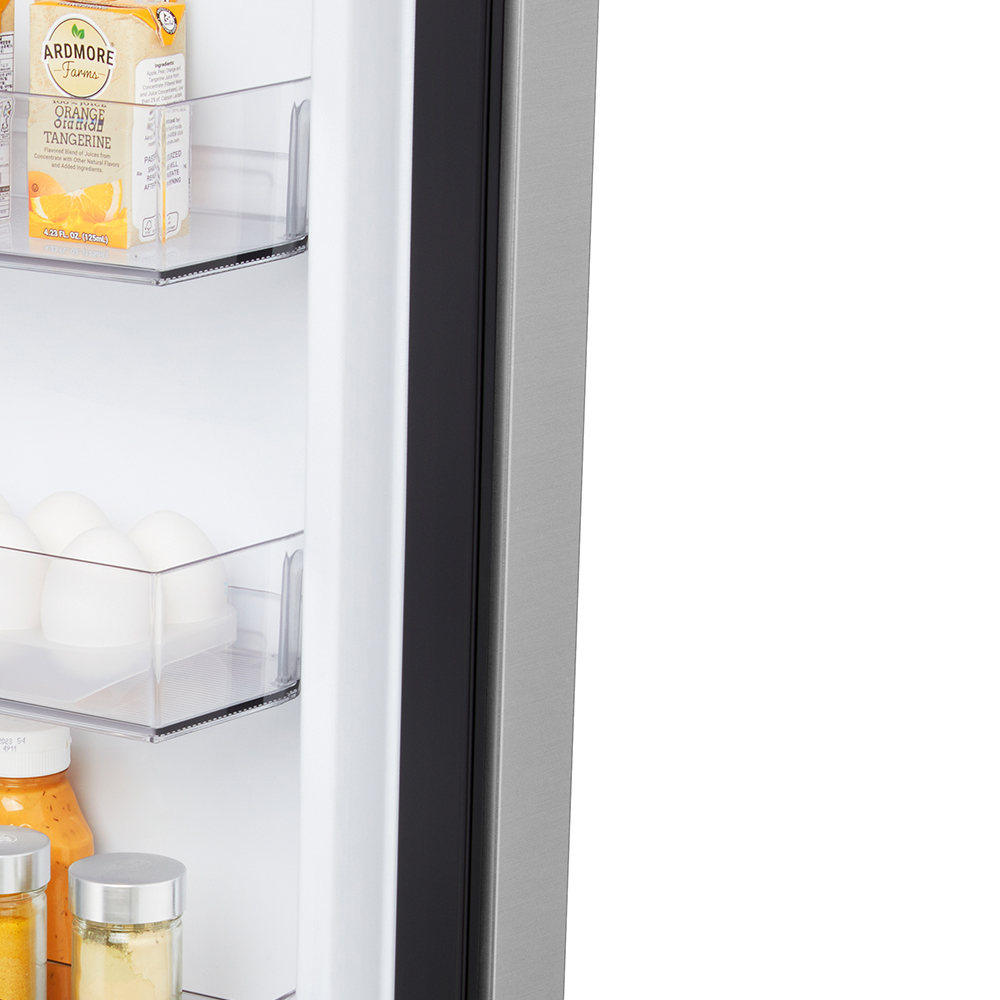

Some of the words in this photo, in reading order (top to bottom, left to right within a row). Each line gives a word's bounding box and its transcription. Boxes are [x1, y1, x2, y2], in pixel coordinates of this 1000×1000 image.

[43, 43, 115, 66] ARDMORE
[62, 60, 99, 80] Farms
[44, 131, 112, 149] TANGERINE
[87, 158, 104, 166] Natural
[104, 160, 120, 168] Flavors
[43, 229, 57, 238] 4.23
[58, 230, 69, 239] FL.
[82, 233, 109, 245] (125mL)
[17, 737, 26, 745] 54
